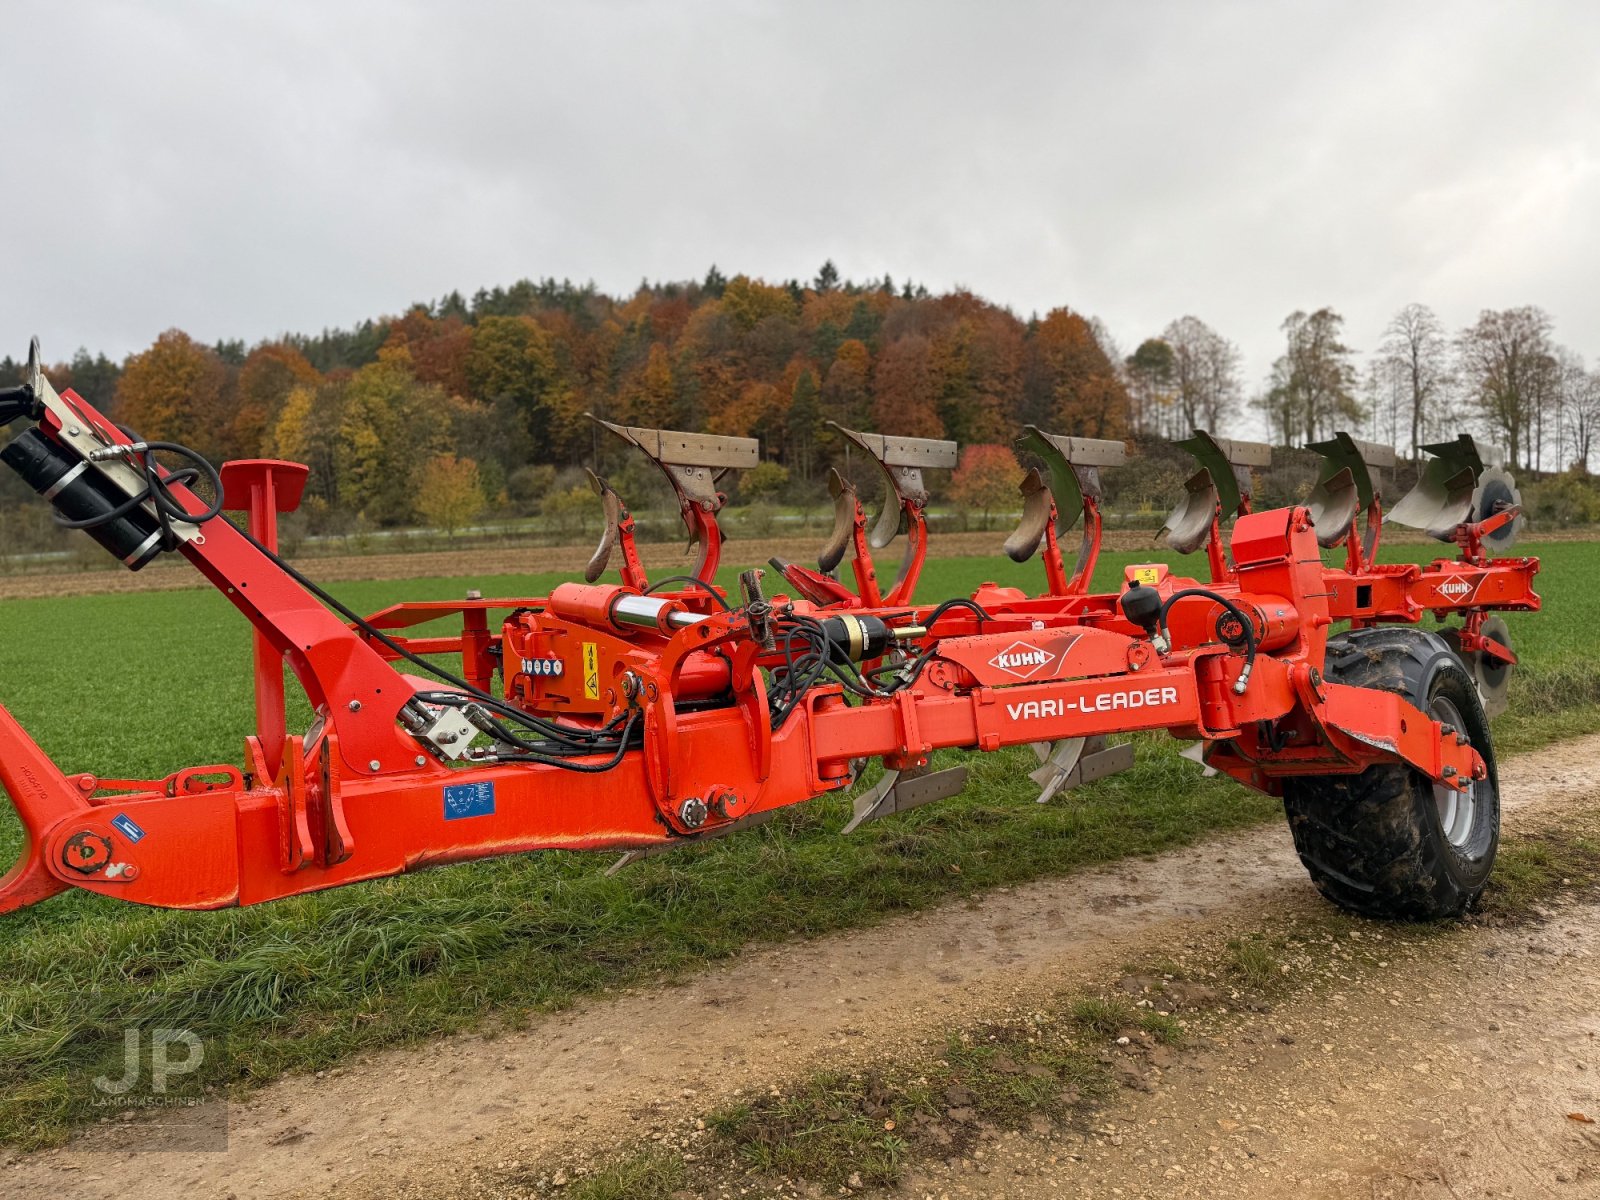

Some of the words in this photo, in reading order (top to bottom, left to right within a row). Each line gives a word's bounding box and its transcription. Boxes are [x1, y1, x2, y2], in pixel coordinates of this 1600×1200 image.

[1442, 583, 1468, 594] KUHN
[998, 651, 1046, 668] KUHN
[1007, 687, 1177, 720] VARI-LEADER
